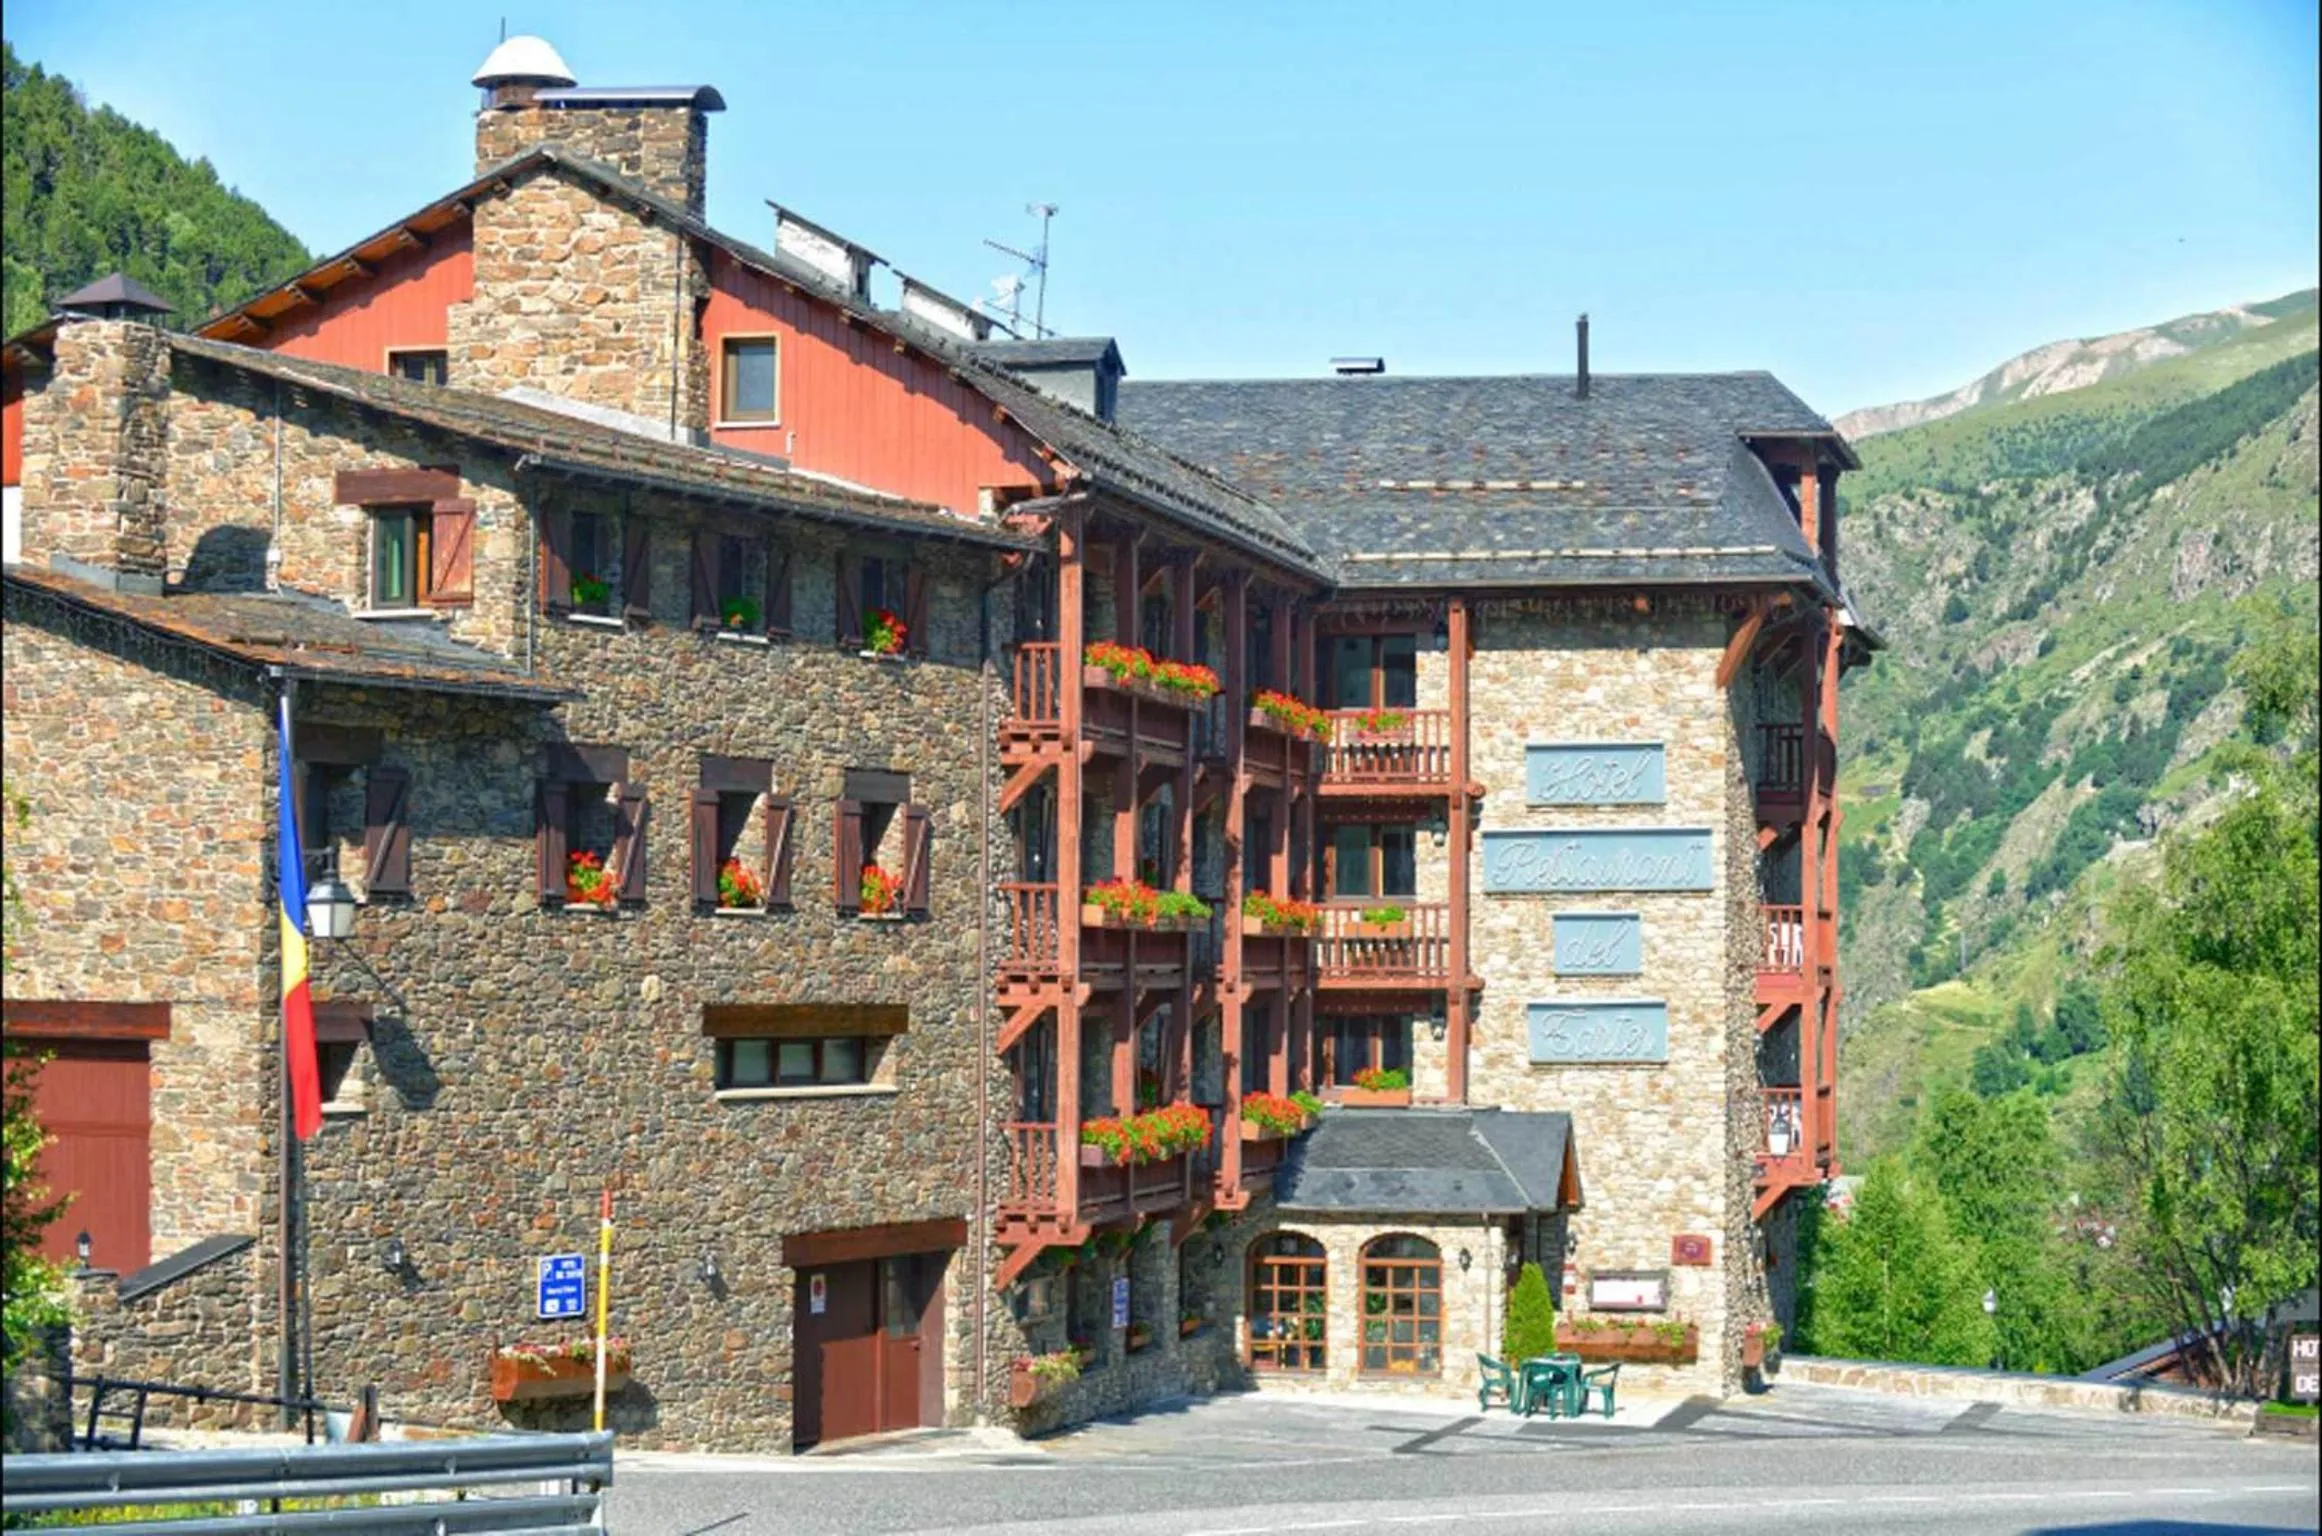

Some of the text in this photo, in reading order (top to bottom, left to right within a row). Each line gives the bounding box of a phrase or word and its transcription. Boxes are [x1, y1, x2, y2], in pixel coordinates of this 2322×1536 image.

[1537, 748, 1652, 801] Hotel
[1492, 839, 1705, 886] Restaurant
[1562, 918, 1632, 968] del
[2292, 1339, 2320, 1357] HO
